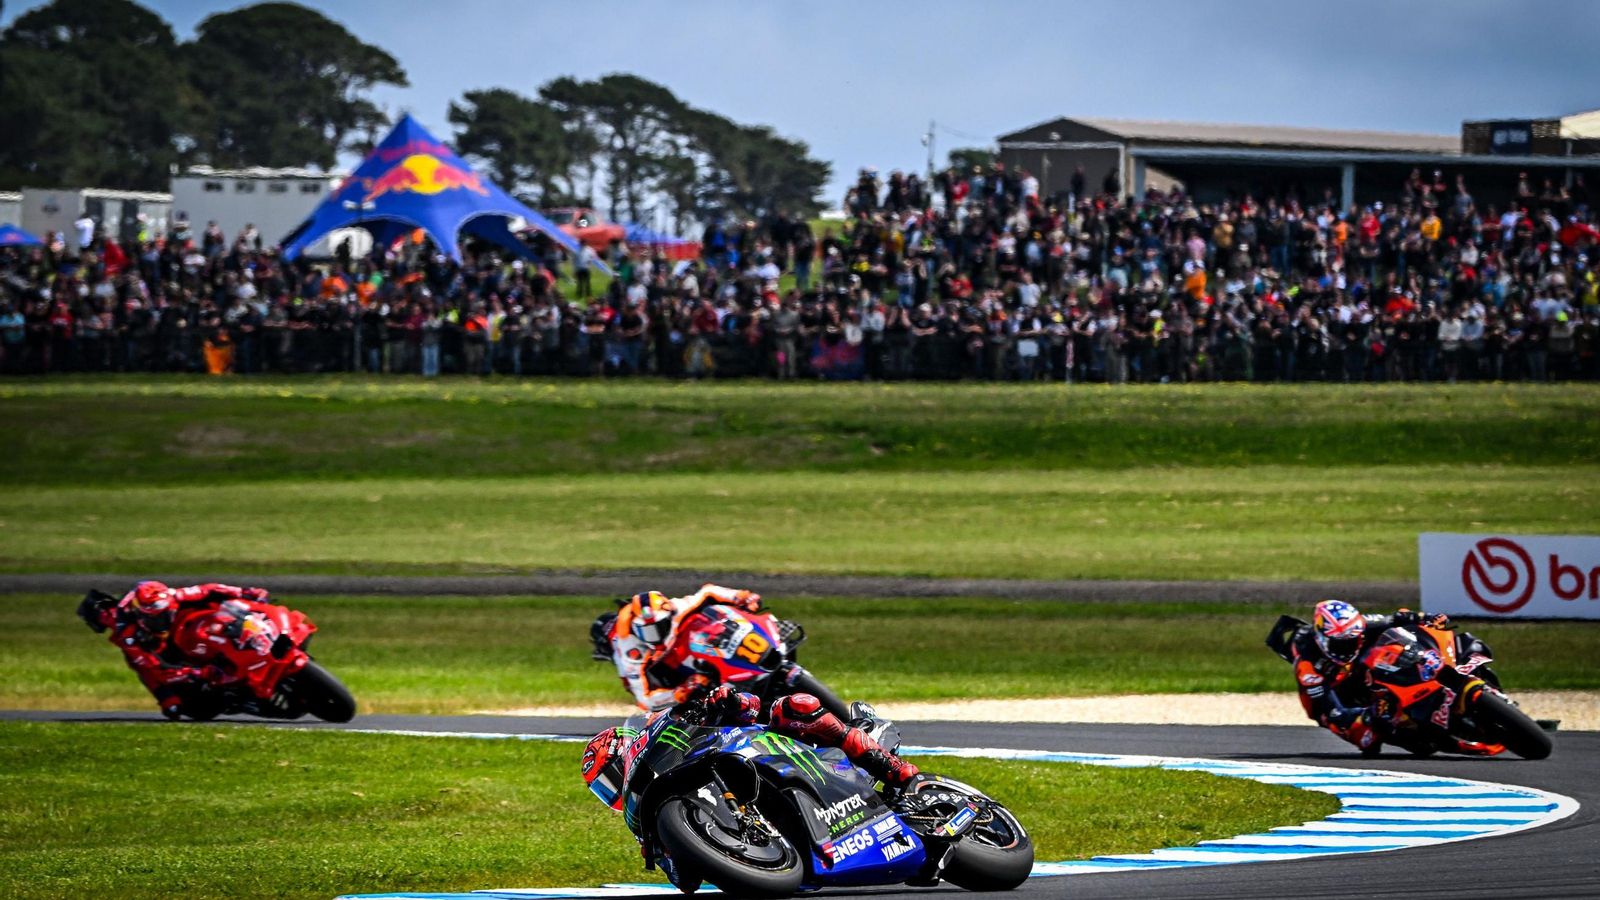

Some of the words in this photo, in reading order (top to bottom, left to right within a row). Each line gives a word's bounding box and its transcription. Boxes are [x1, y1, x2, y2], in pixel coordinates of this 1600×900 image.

[736, 632, 770, 664] 10
[813, 793, 867, 826] MONSTER
[828, 811, 866, 836] NERGY
[825, 829, 874, 864] ENEOS
